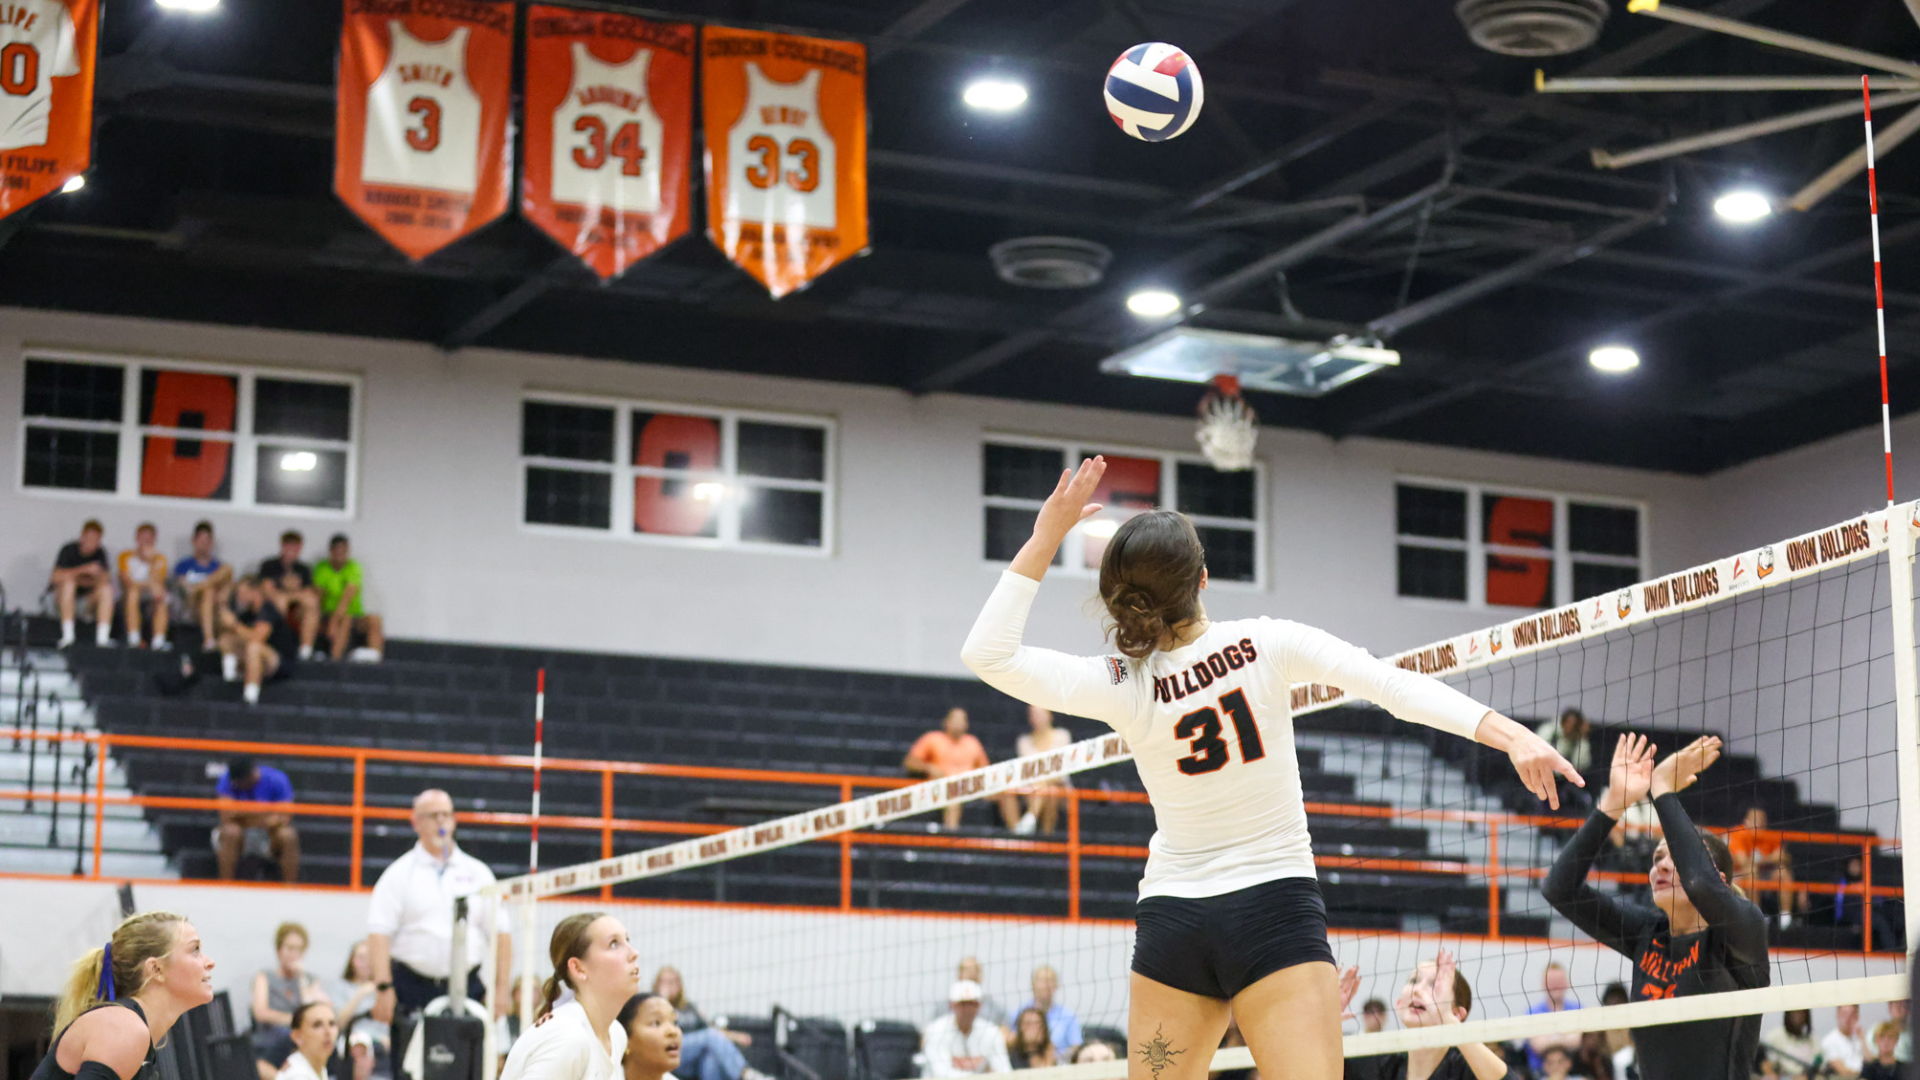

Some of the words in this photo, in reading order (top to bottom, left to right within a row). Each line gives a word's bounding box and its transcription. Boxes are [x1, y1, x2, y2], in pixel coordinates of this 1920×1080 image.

[406, 94, 442, 152] 3
[571, 114, 646, 177] 34
[745, 134, 820, 193] 33
[1786, 537, 1818, 572] UNION
[1818, 519, 1870, 563] BULLDOGS
[1643, 579, 1671, 614] UNION
[1671, 566, 1720, 606] BULLDOGS
[1512, 619, 1539, 649] UNION
[1539, 607, 1581, 642] BULLDOGS
[1173, 687, 1266, 777] 31
[1640, 940, 1699, 983] MILLIN
